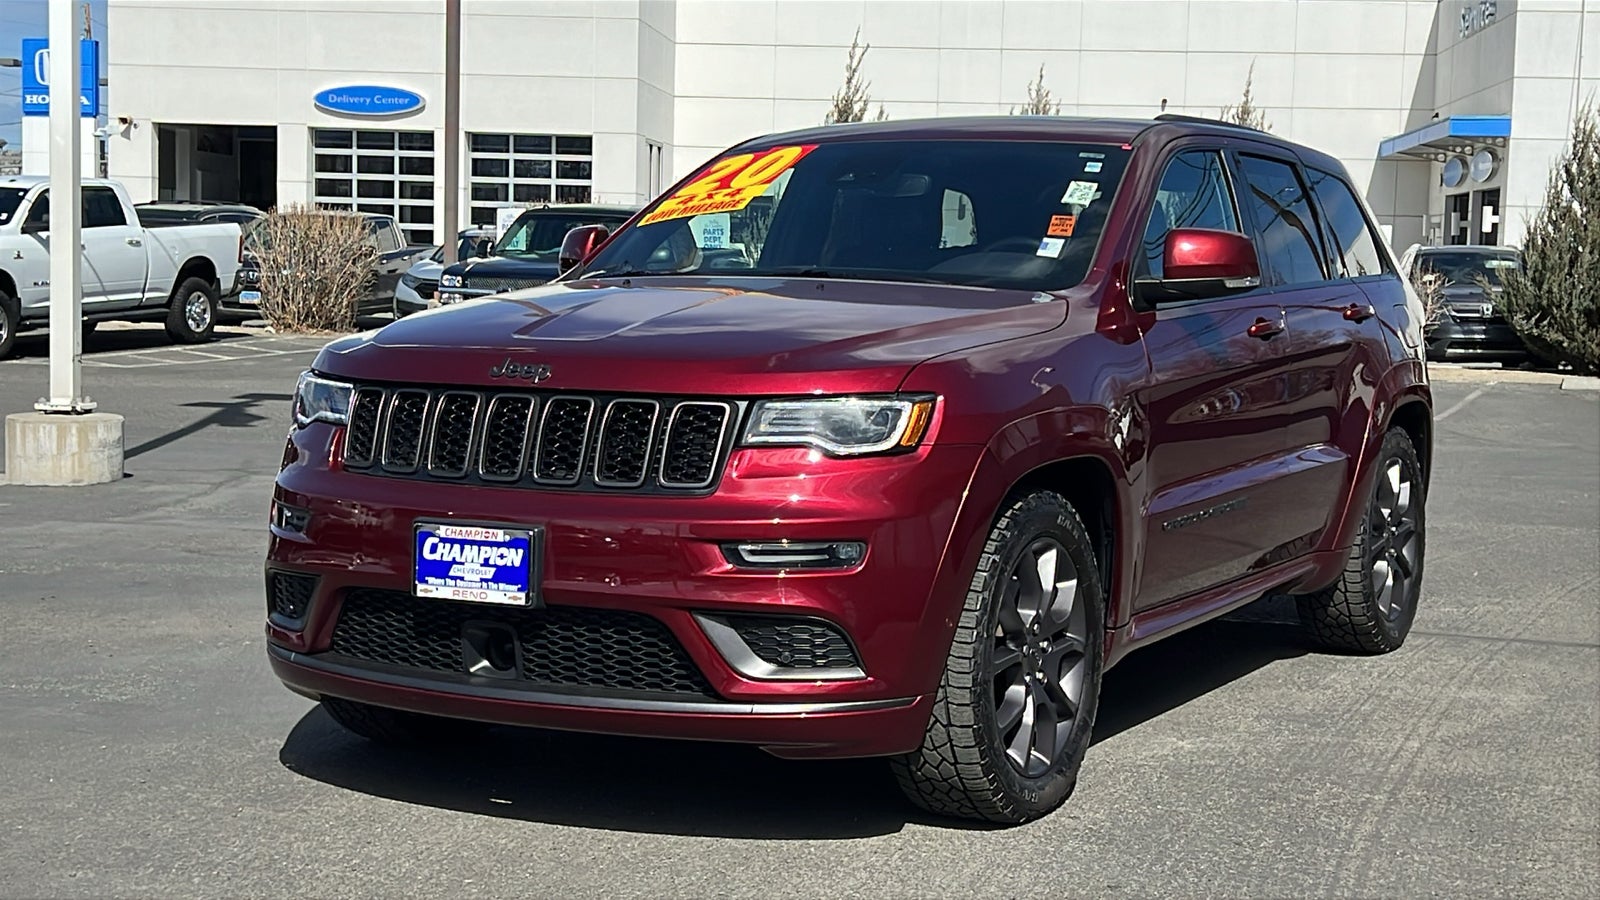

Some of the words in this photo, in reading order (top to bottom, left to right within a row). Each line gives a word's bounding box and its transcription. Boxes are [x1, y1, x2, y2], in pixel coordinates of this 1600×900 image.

[24, 94, 90, 105] HOA
[328, 93, 370, 105] Delivery
[373, 95, 410, 104] Center
[673, 146, 802, 197] 20
[676, 198, 746, 216] MILEAGE
[703, 228, 724, 236] PARTS
[490, 356, 552, 384] Jeep
[444, 527, 499, 540] CHAMPION
[452, 565, 493, 576] CHEVROLET
[452, 589, 489, 600] RENO
